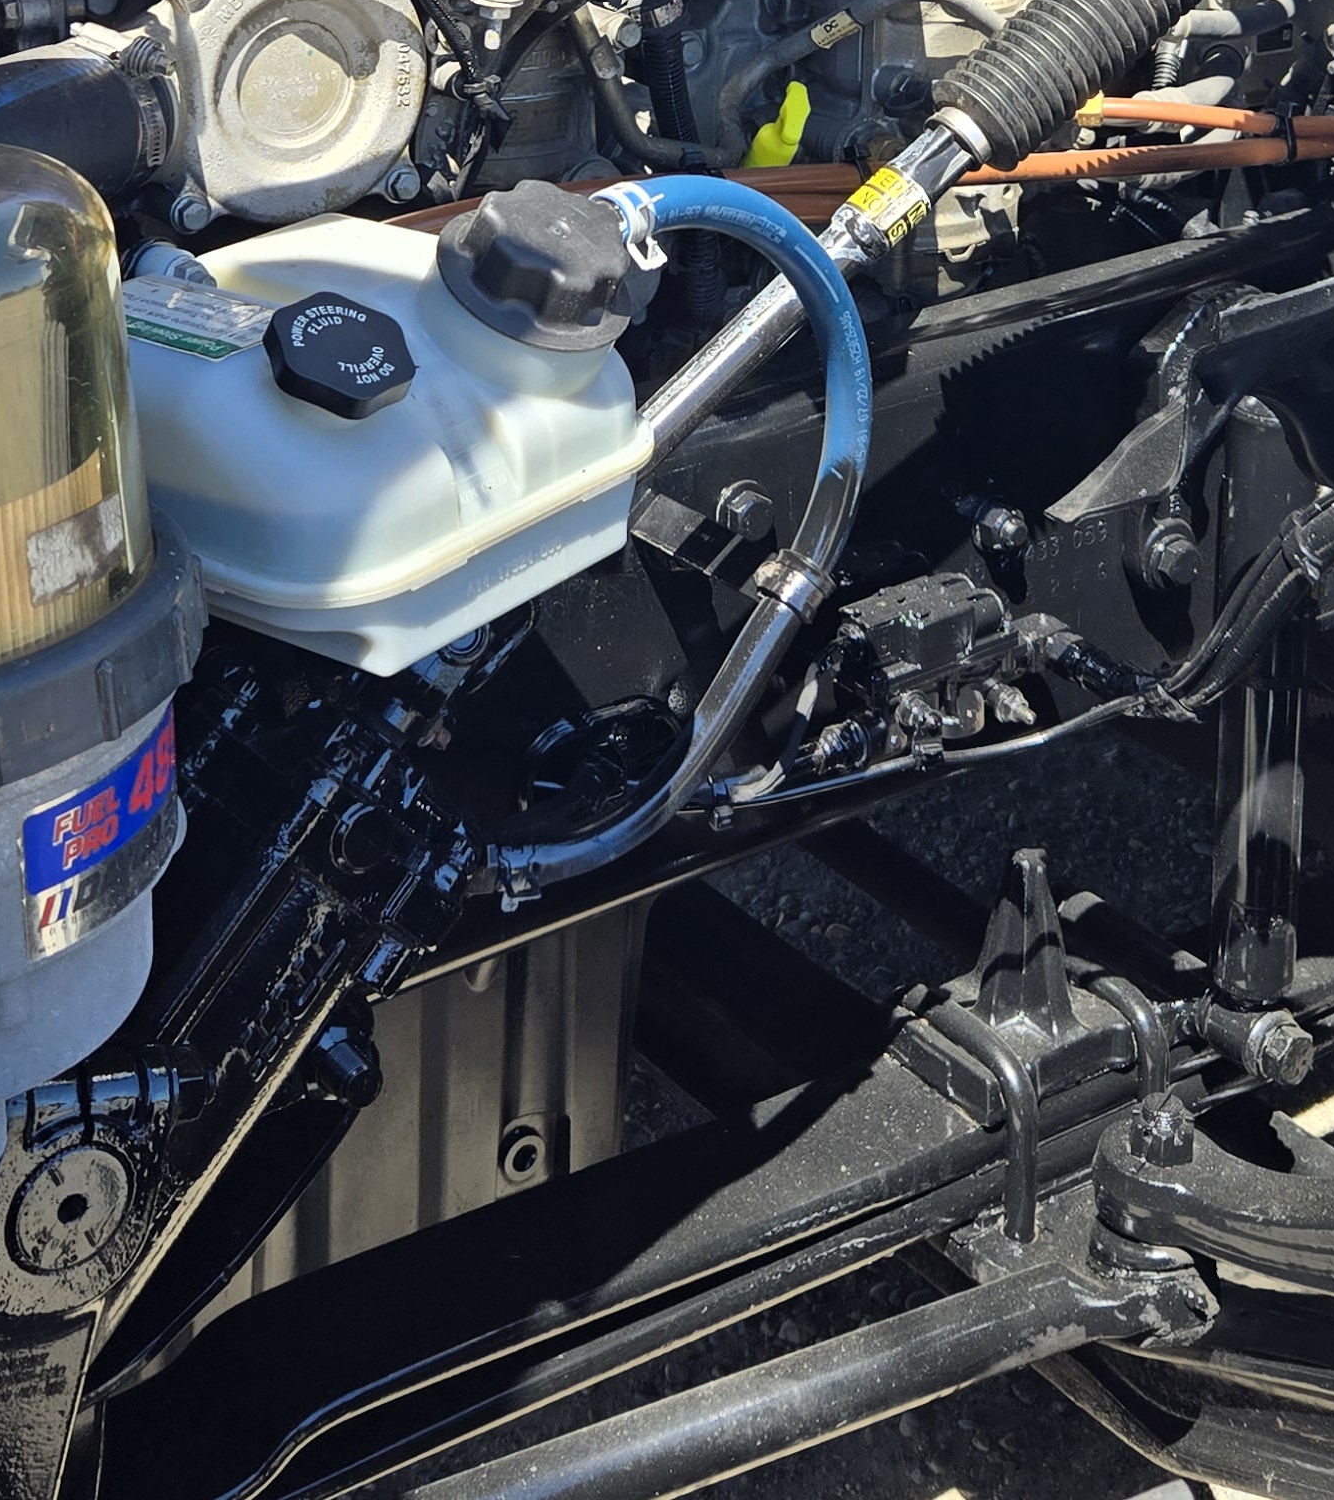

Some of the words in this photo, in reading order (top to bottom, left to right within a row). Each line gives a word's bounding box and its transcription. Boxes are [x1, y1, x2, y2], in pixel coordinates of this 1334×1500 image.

[824, 19, 839, 33] DC
[873, 171, 903, 192] TEP
[859, 190, 883, 212] NO
[129, 319, 184, 341] Steering
[291, 315, 310, 347] POWER
[305, 305, 367, 322] STEERING
[307, 315, 343, 335] FLUID
[188, 336, 225, 351] Power
[337, 346, 385, 373] OVERFILL
[379, 362, 395, 377] DO
[356, 372, 381, 384] NOT
[129, 703, 176, 815] 48
[53, 786, 120, 846] FUEL
[63, 814, 120, 871] PRO
